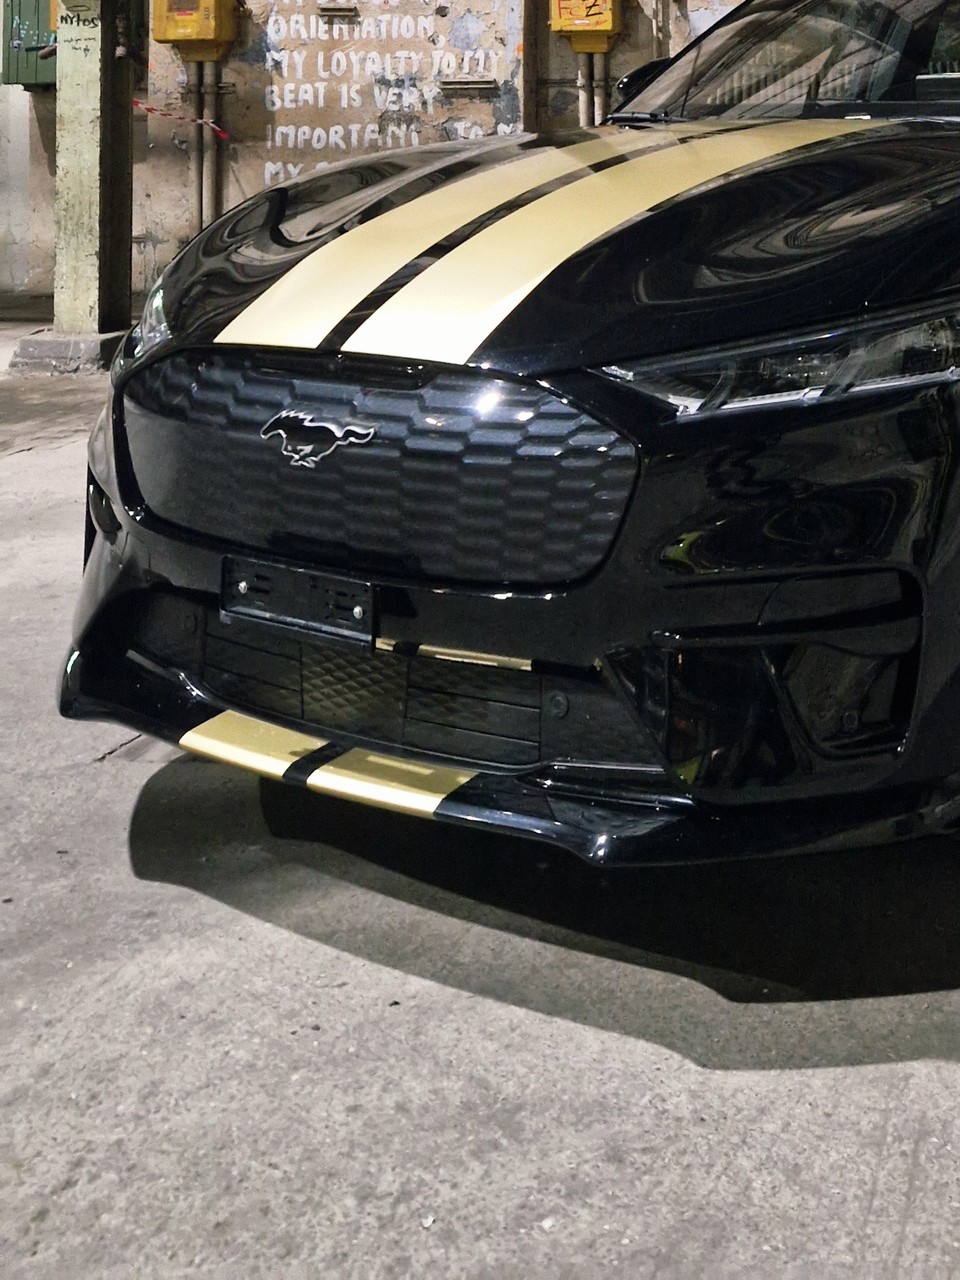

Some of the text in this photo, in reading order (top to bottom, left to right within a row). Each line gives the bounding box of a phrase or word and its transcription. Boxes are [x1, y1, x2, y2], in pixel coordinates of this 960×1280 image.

[265, 50, 308, 80] MY
[317, 49, 424, 82] LOYALTY
[431, 49, 457, 78] TO
[265, 82, 328, 111] BEAT
[338, 84, 363, 109] IS
